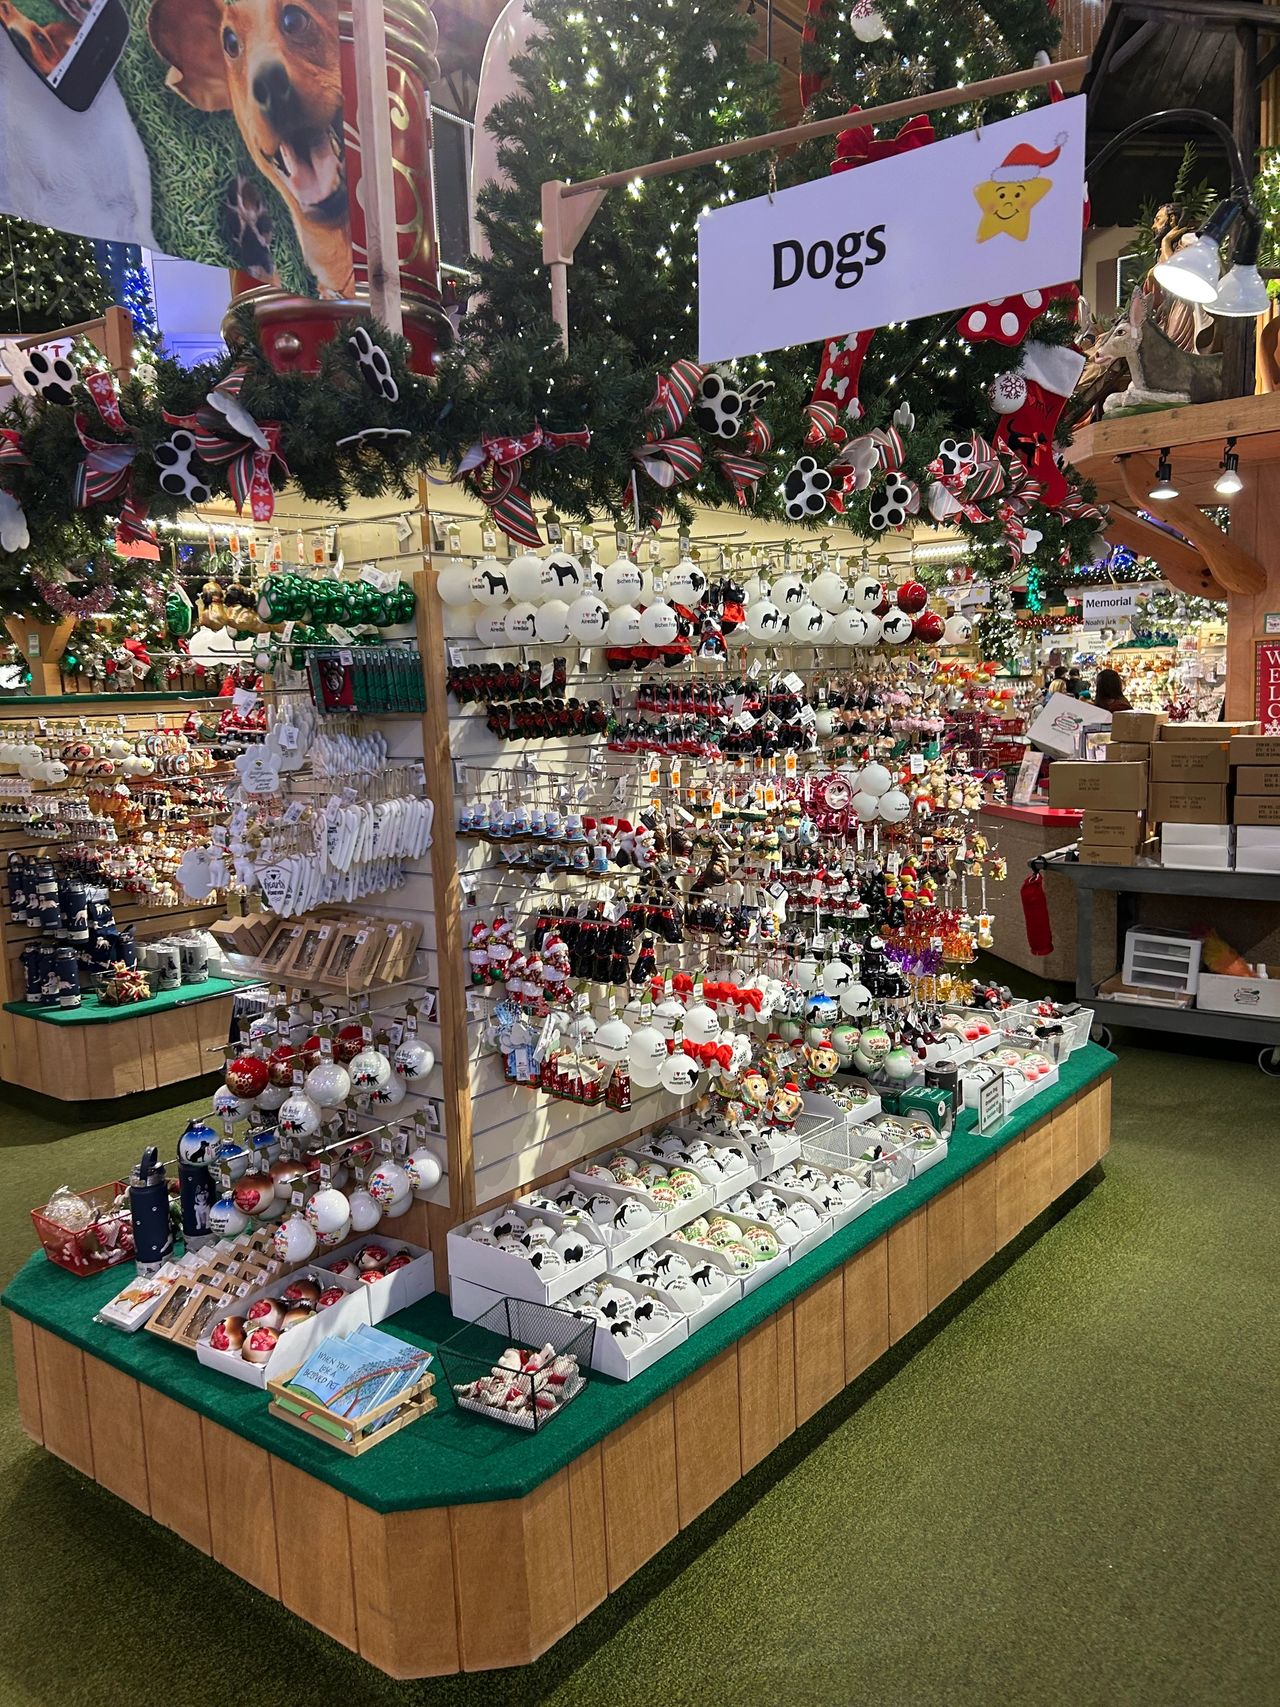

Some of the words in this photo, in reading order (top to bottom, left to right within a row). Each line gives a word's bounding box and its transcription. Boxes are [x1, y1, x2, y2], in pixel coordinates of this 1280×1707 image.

[773, 224, 887, 290] Dogs
[1085, 596, 1132, 608] Memorial
[317, 1351, 337, 1365] WHEN
[337, 1361, 350, 1371] YOU
[303, 1368, 328, 1384] BELOVED
[325, 1380, 340, 1391] PET
